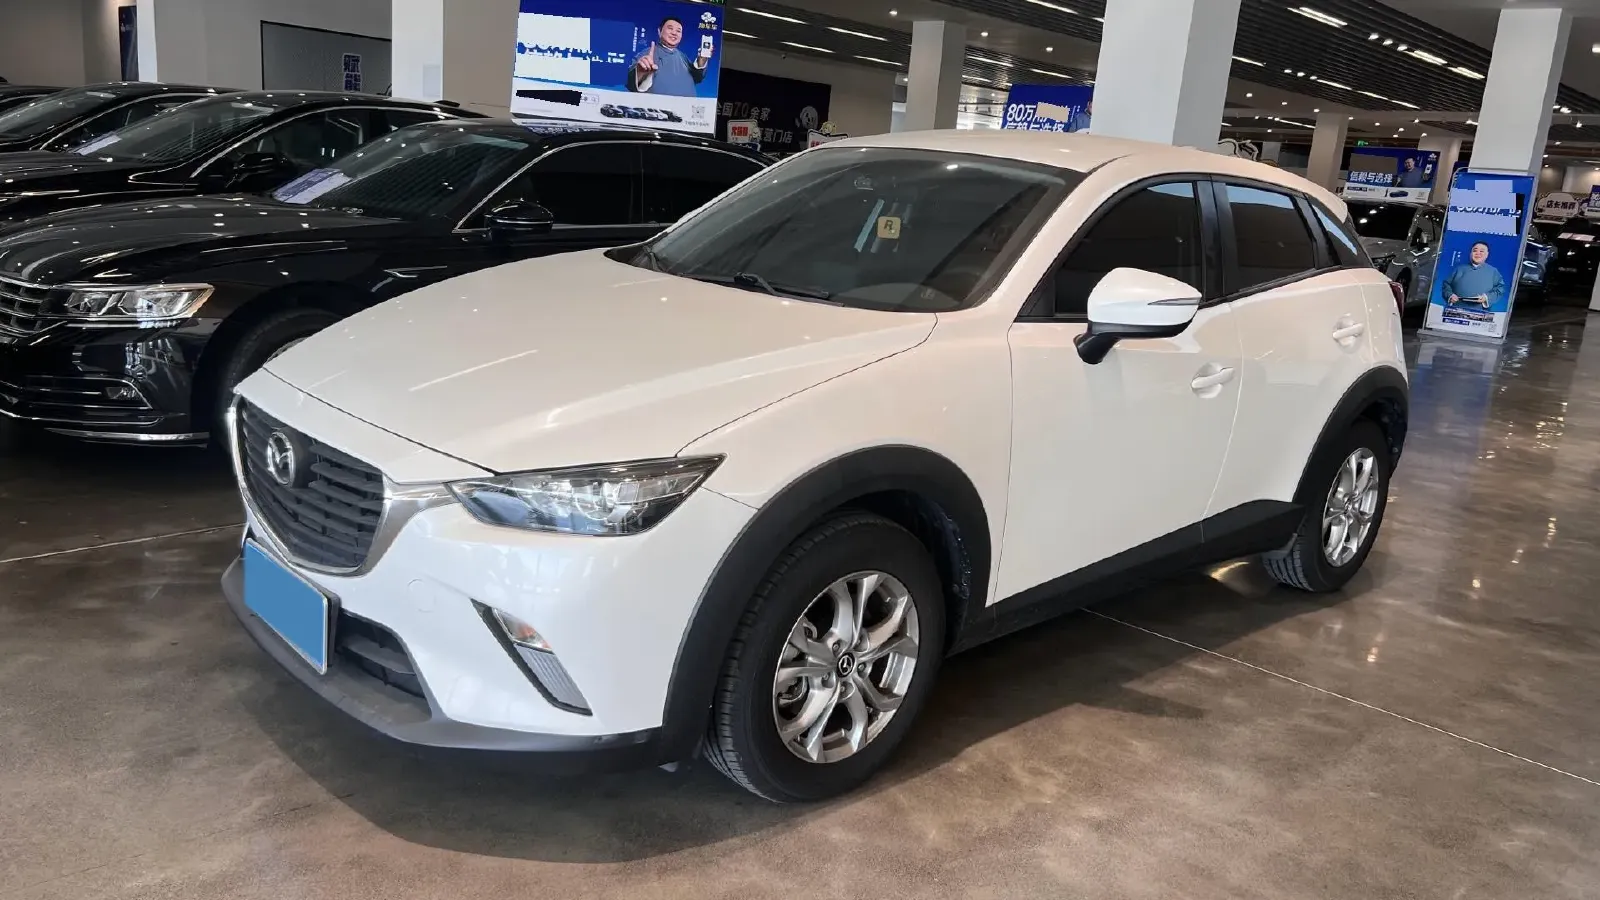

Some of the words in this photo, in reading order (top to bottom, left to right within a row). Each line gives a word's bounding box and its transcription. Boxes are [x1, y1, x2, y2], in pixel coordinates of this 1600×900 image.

[1350, 171, 1393, 183] 信赖与选择
